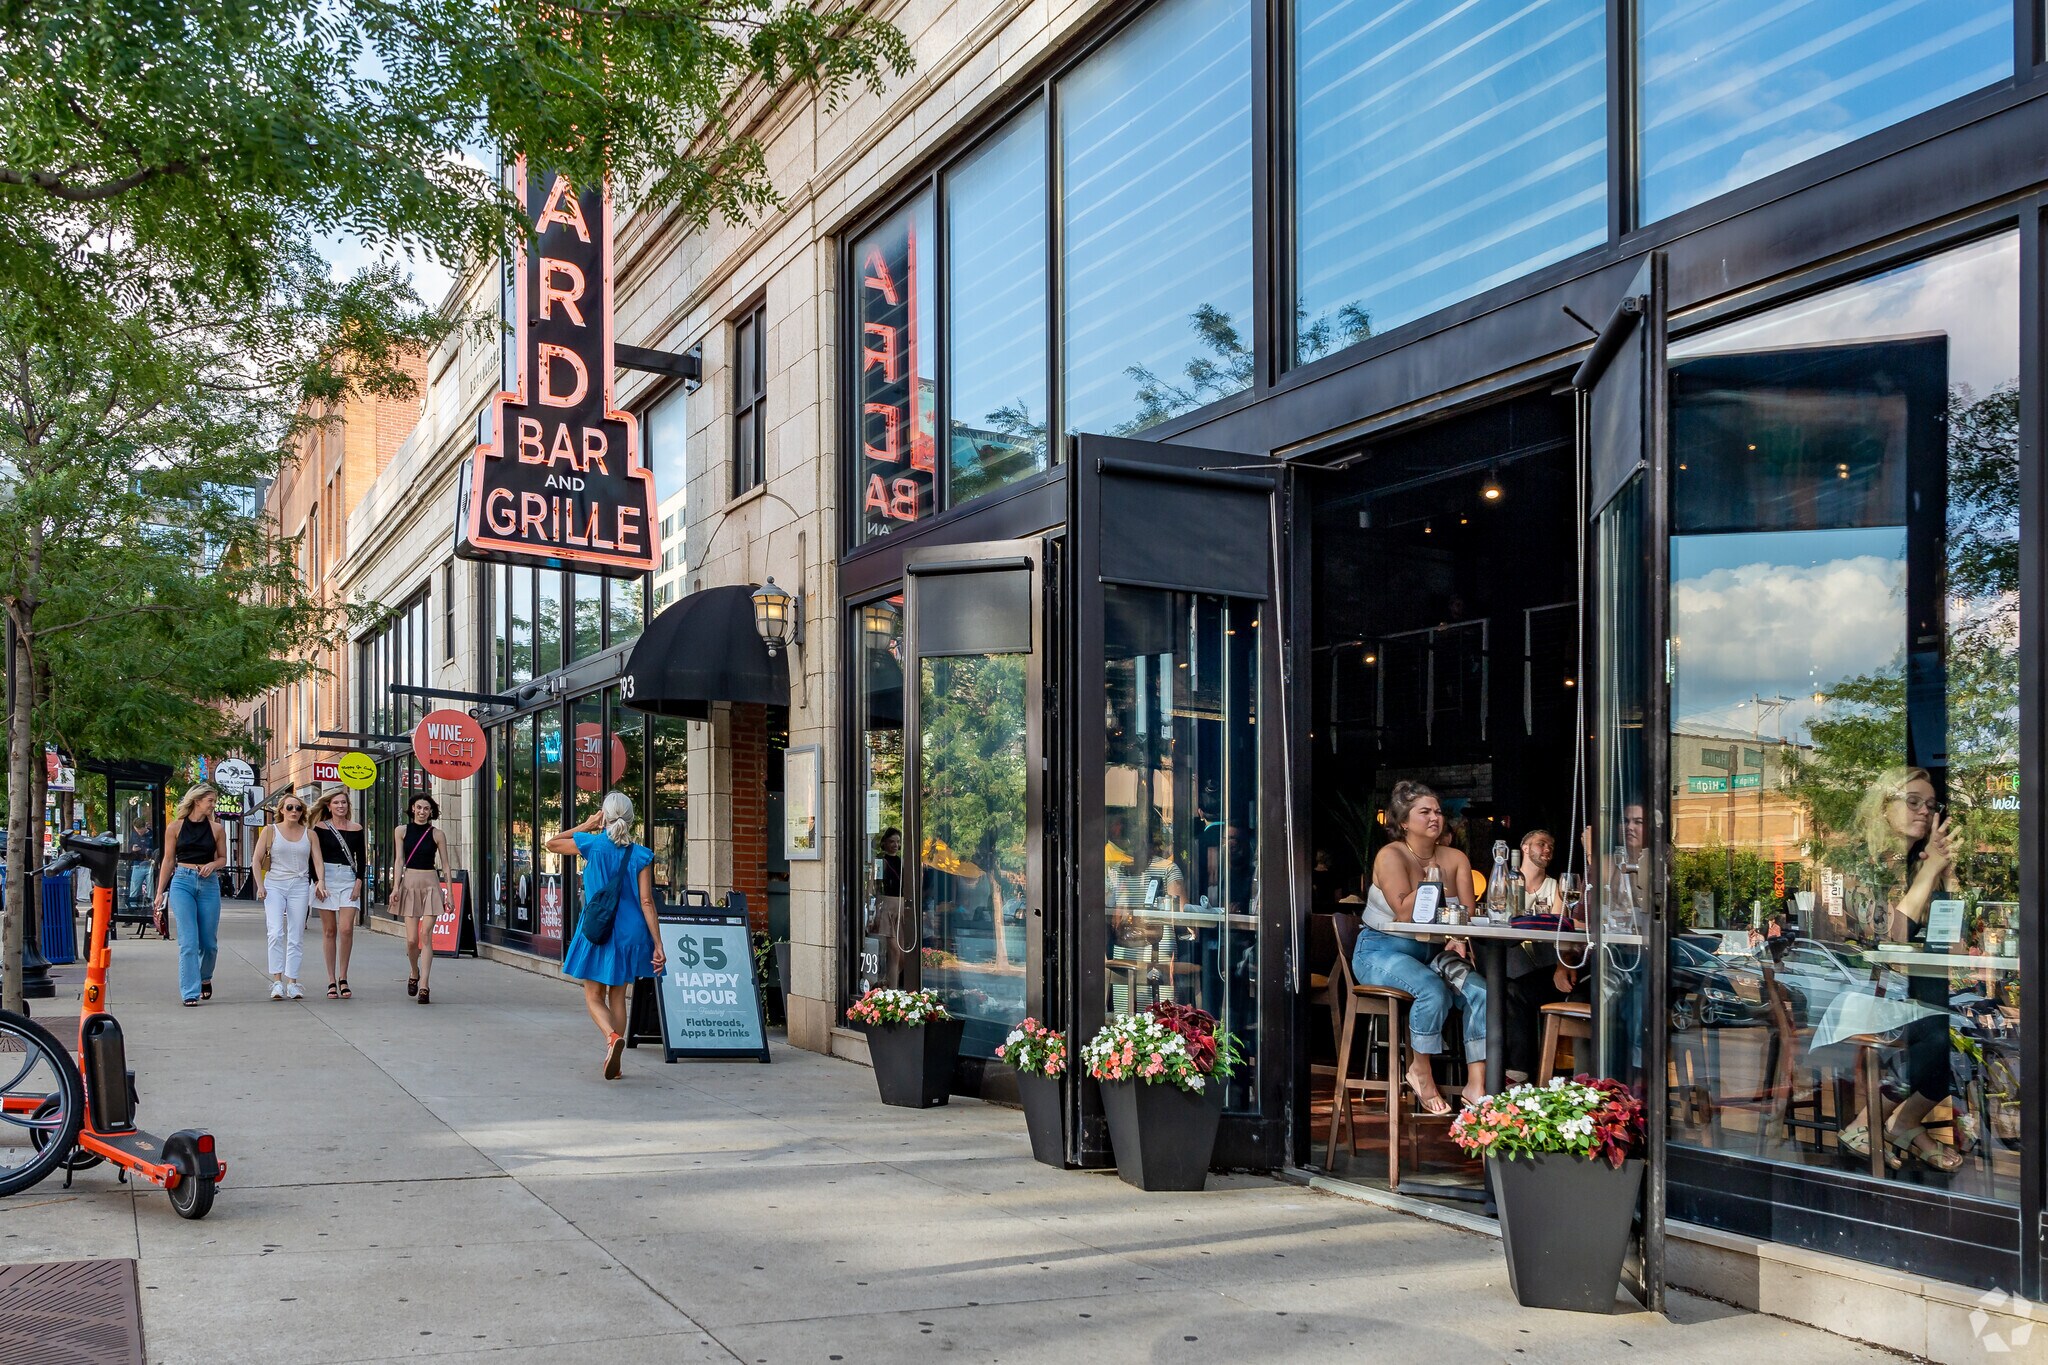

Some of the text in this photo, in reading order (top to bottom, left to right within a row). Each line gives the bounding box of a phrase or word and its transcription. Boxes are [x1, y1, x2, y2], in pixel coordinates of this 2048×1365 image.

[535, 173, 592, 408] ARD
[470, 347, 500, 394] ESTABLISHE
[518, 416, 609, 476] BAR
[544, 474, 585, 492] AND
[486, 488, 641, 553] GRILLE
[427, 723, 463, 742] WINE
[429, 740, 473, 758] HIGH
[1986, 775, 2020, 791] EVER
[1992, 795, 2020, 810] Welc
[432, 924, 450, 935] CAL
[678, 934, 728, 970] $5
[860, 952, 878, 975] 793
[674, 972, 740, 988] HAPPY
[682, 989, 738, 1005] HOUR
[686, 1018, 745, 1028] Flatbreads,
[680, 1028, 750, 1039] Apps & Drinks
